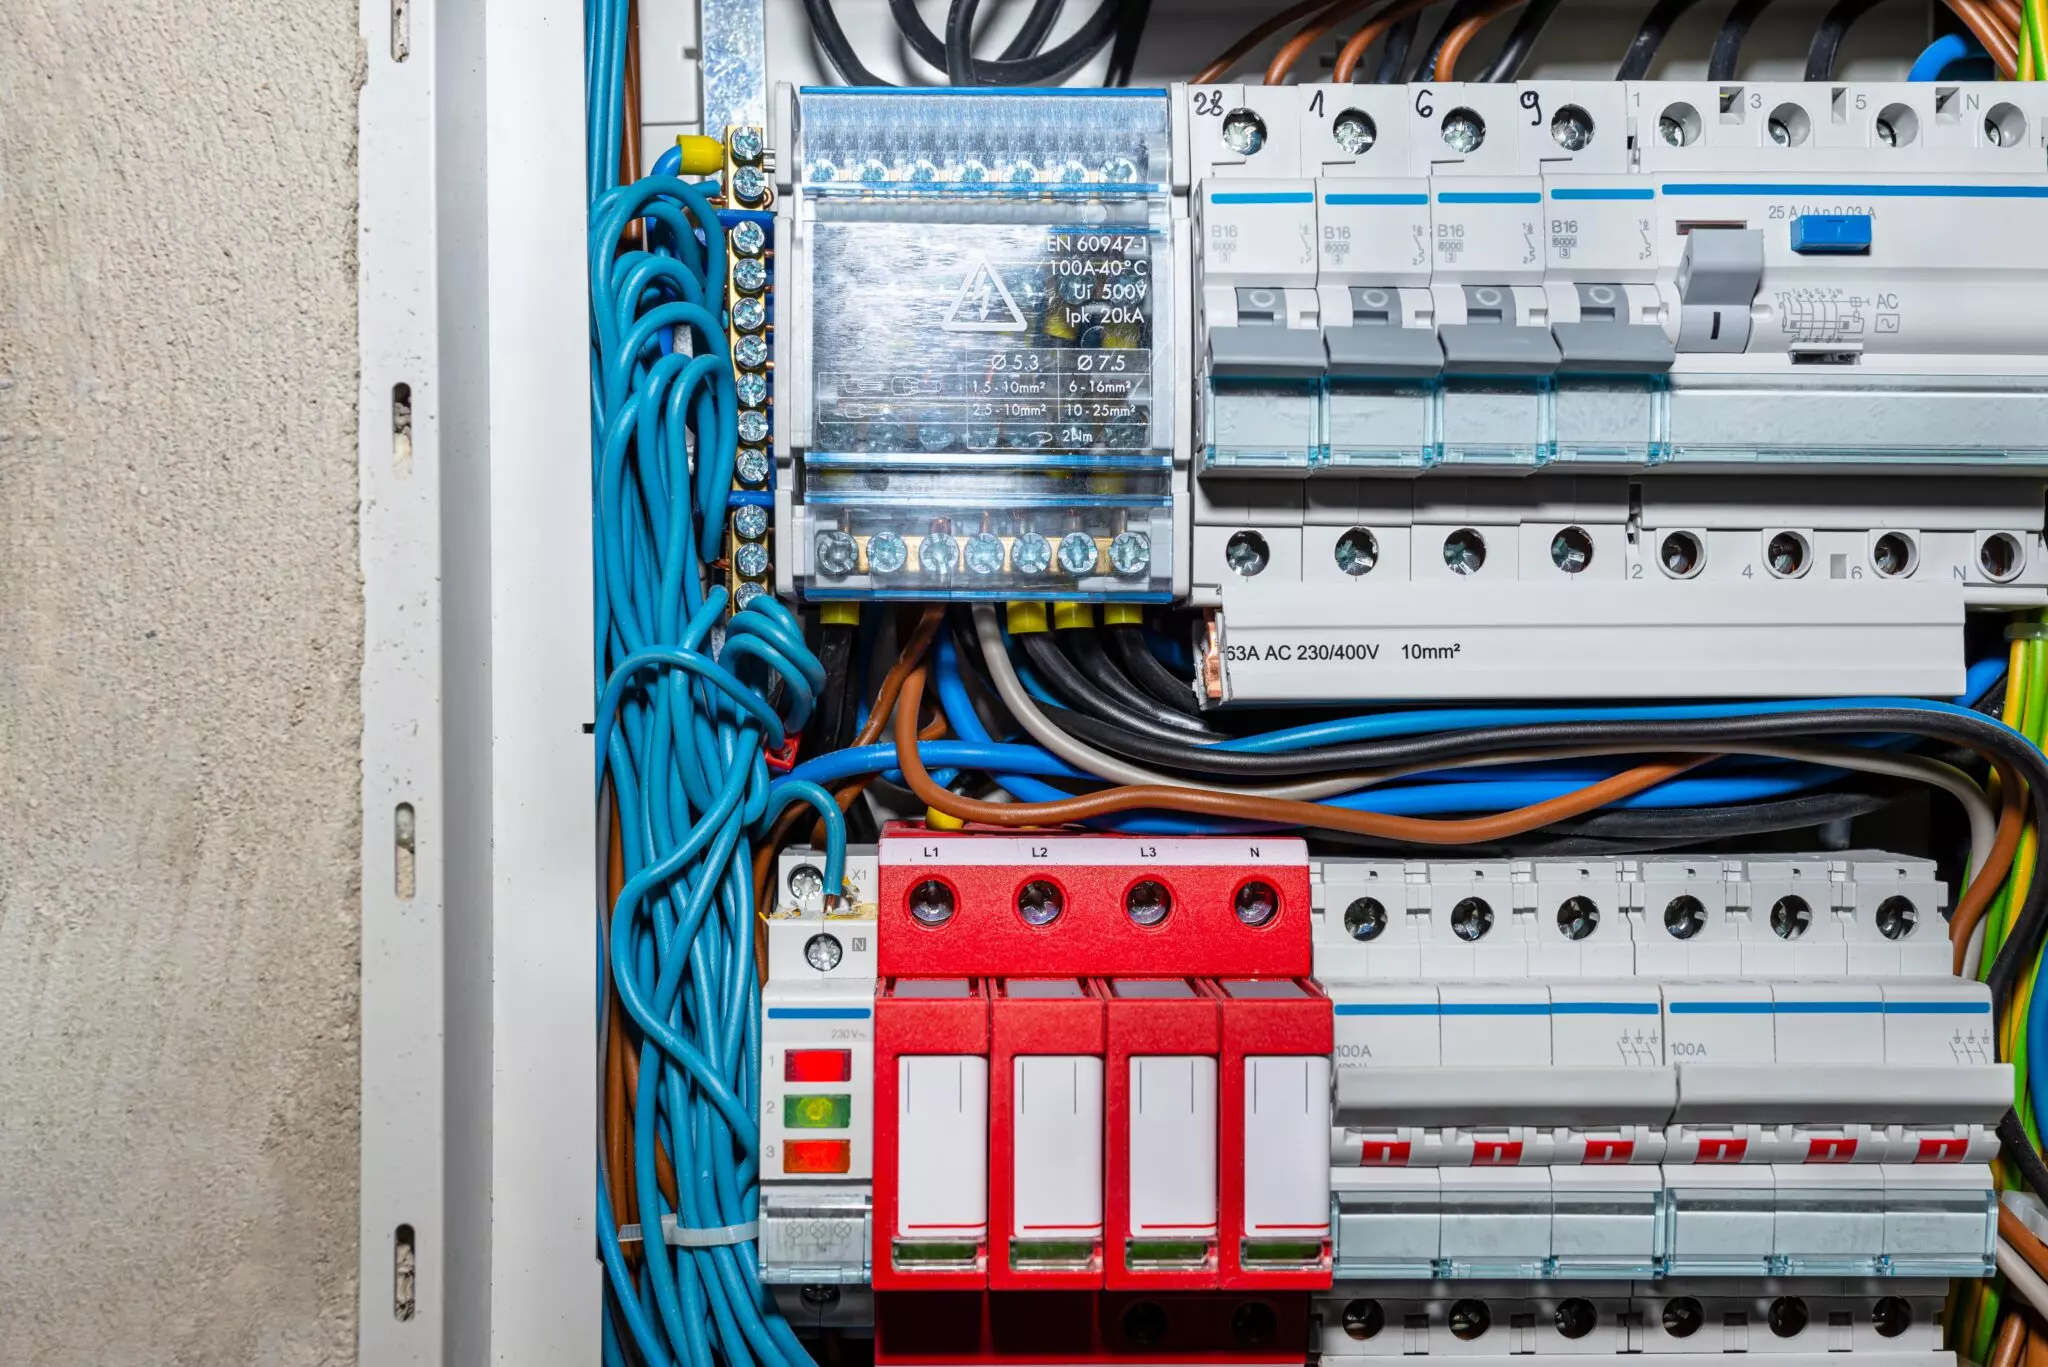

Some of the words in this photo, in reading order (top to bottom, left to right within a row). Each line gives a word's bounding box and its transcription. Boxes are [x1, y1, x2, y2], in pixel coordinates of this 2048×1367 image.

[1194, 90, 1224, 117] 28
[1309, 89, 1325, 118] 1
[1416, 89, 1434, 118] 6
[1520, 90, 1542, 126] 9
[1750, 94, 1763, 109] 3
[1855, 94, 1867, 110] 5
[1965, 94, 1980, 109] N
[1768, 205, 1785, 219] 25
[1211, 225, 1238, 238] B16
[1324, 226, 1351, 239] B16
[1437, 224, 1464, 237] B16
[1551, 220, 1578, 233] B16
[1047, 236, 1071, 252] EN
[1077, 236, 1147, 252] 60947-1
[1101, 284, 1147, 300] 500V
[1877, 293, 1899, 309] AC
[1100, 306, 1145, 323] 20kA
[1012, 355, 1040, 371] 5.3
[1098, 355, 1126, 371] 7.5
[972, 381, 991, 393] 1.5
[973, 404, 992, 416] 2.5
[1062, 430, 1093, 442] 2Nm
[1632, 565, 1643, 580] 2
[1742, 565, 1753, 579] 4
[1850, 565, 1863, 580] 6
[1953, 565, 1967, 580] N
[1227, 646, 1260, 661] 63A
[1264, 645, 1292, 661] AC
[1297, 644, 1380, 661] 230/400V
[1401, 643, 1461, 660] 10mm²
[923, 847, 939, 858] L1
[1031, 847, 1048, 858] L2
[1140, 847, 1157, 858] L3
[1250, 847, 1260, 858] N
[1335, 1044, 1373, 1058] 100A
[1670, 1042, 1708, 1056] 100A
[766, 1102, 776, 1114] 2
[766, 1146, 775, 1158] 3
